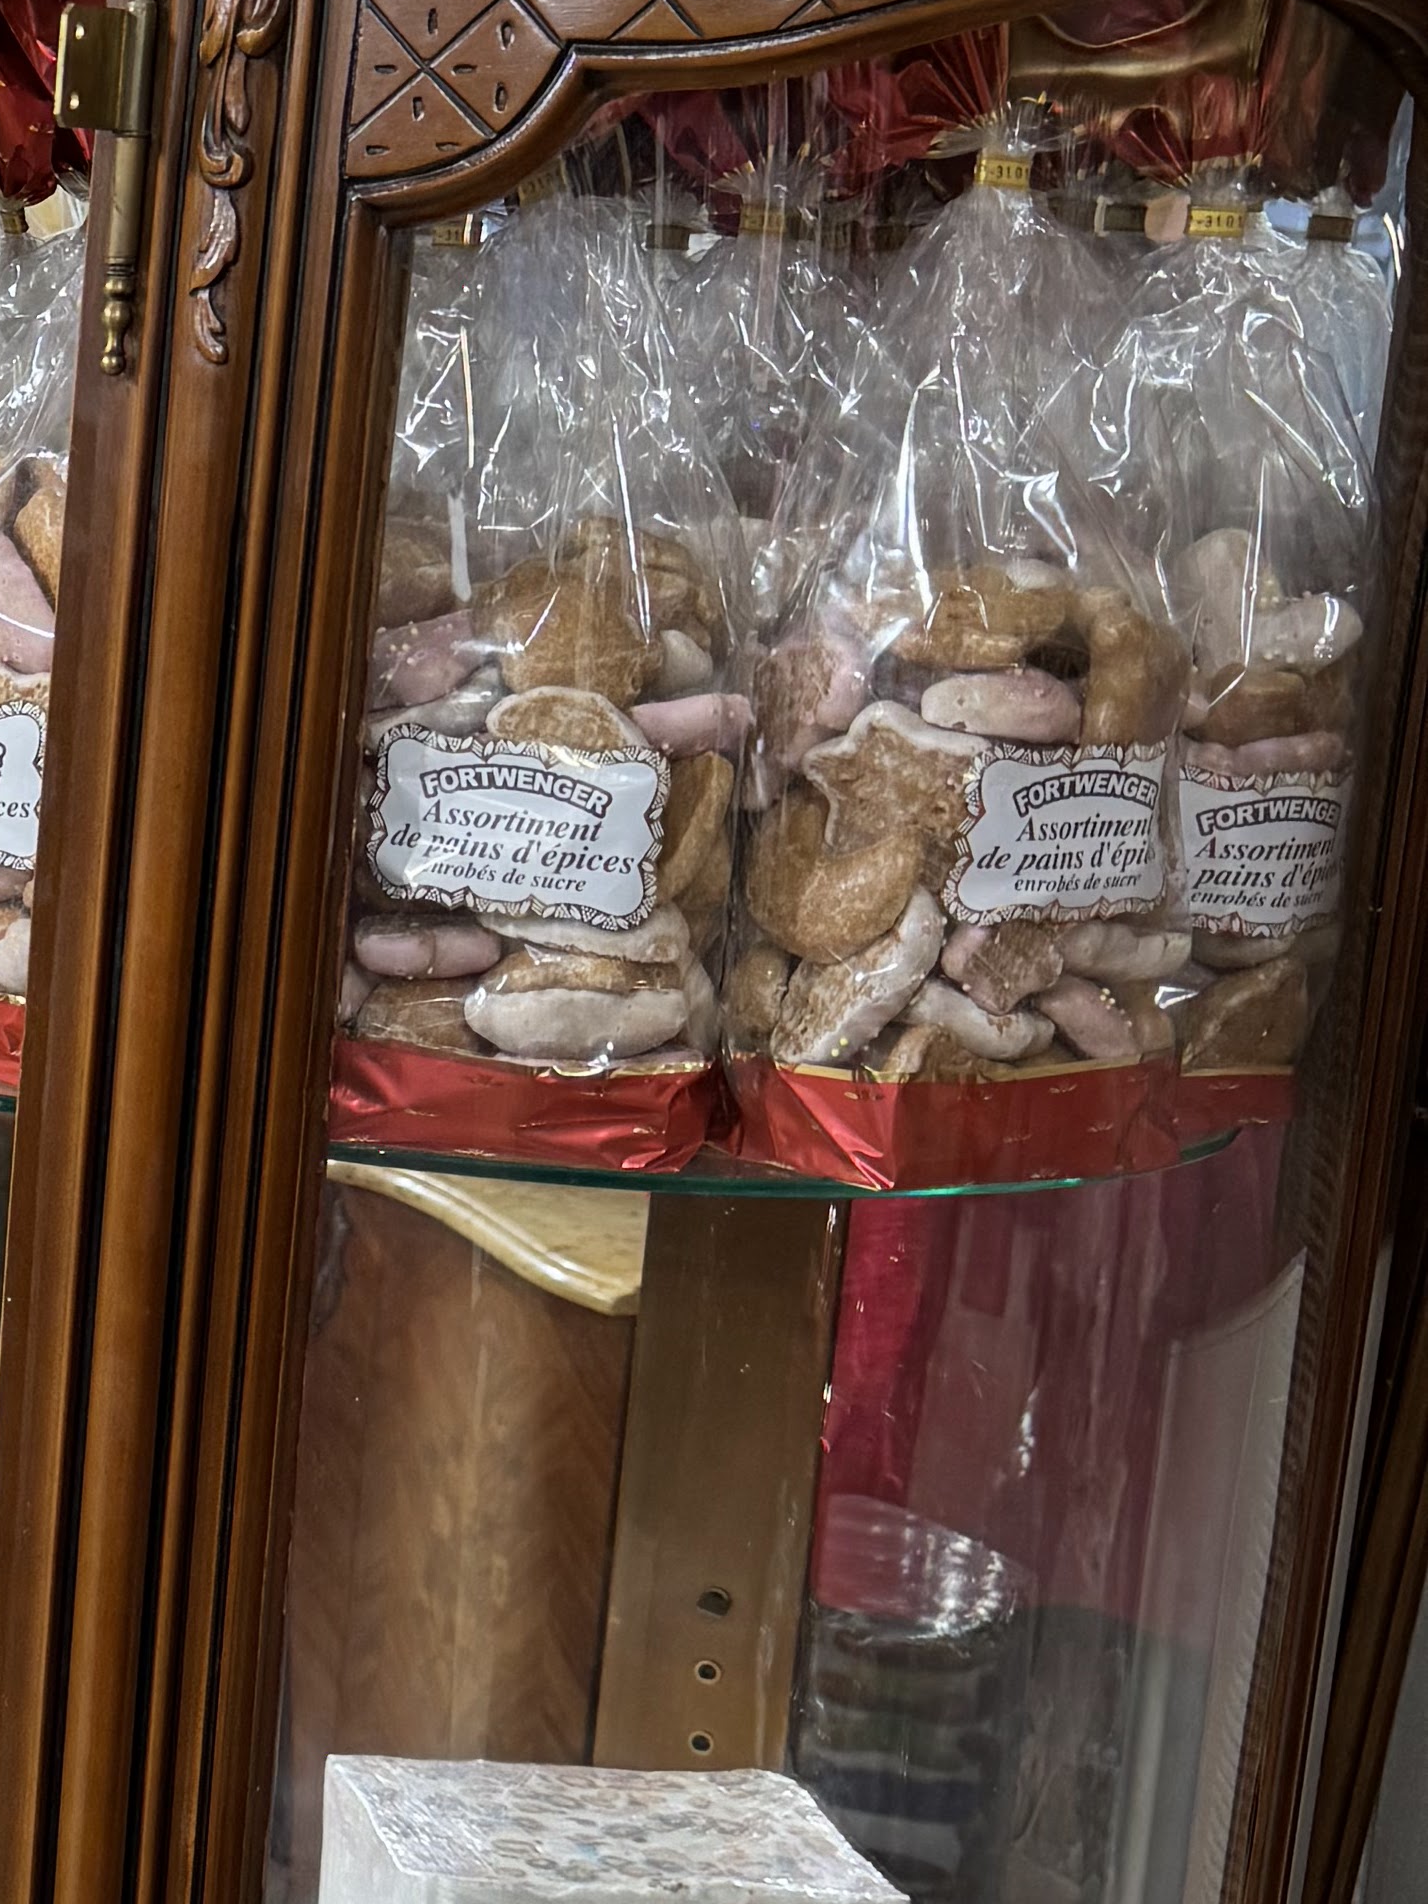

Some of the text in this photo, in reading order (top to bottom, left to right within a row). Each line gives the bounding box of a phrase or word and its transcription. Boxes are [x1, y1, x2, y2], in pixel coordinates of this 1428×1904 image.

[421, 765, 612, 817] FORTWENGER
[1013, 771, 1158, 817] FORTWENGER
[423, 799, 603, 842] Assortiment
[1196, 797, 1341, 836] FORTWENGE
[391, 823, 421, 848] de
[512, 840, 634, 874] d'épices
[977, 846, 1011, 869] de
[1013, 844, 1084, 876] pains
[423, 861, 586, 892] nrobés de sucre
[1014, 874, 1081, 892] enrobés
[1083, 873, 1100, 890] de
[1193, 864, 1276, 889] pains
[1190, 890, 1266, 908] enrobés
[1271, 892, 1291, 908] de
